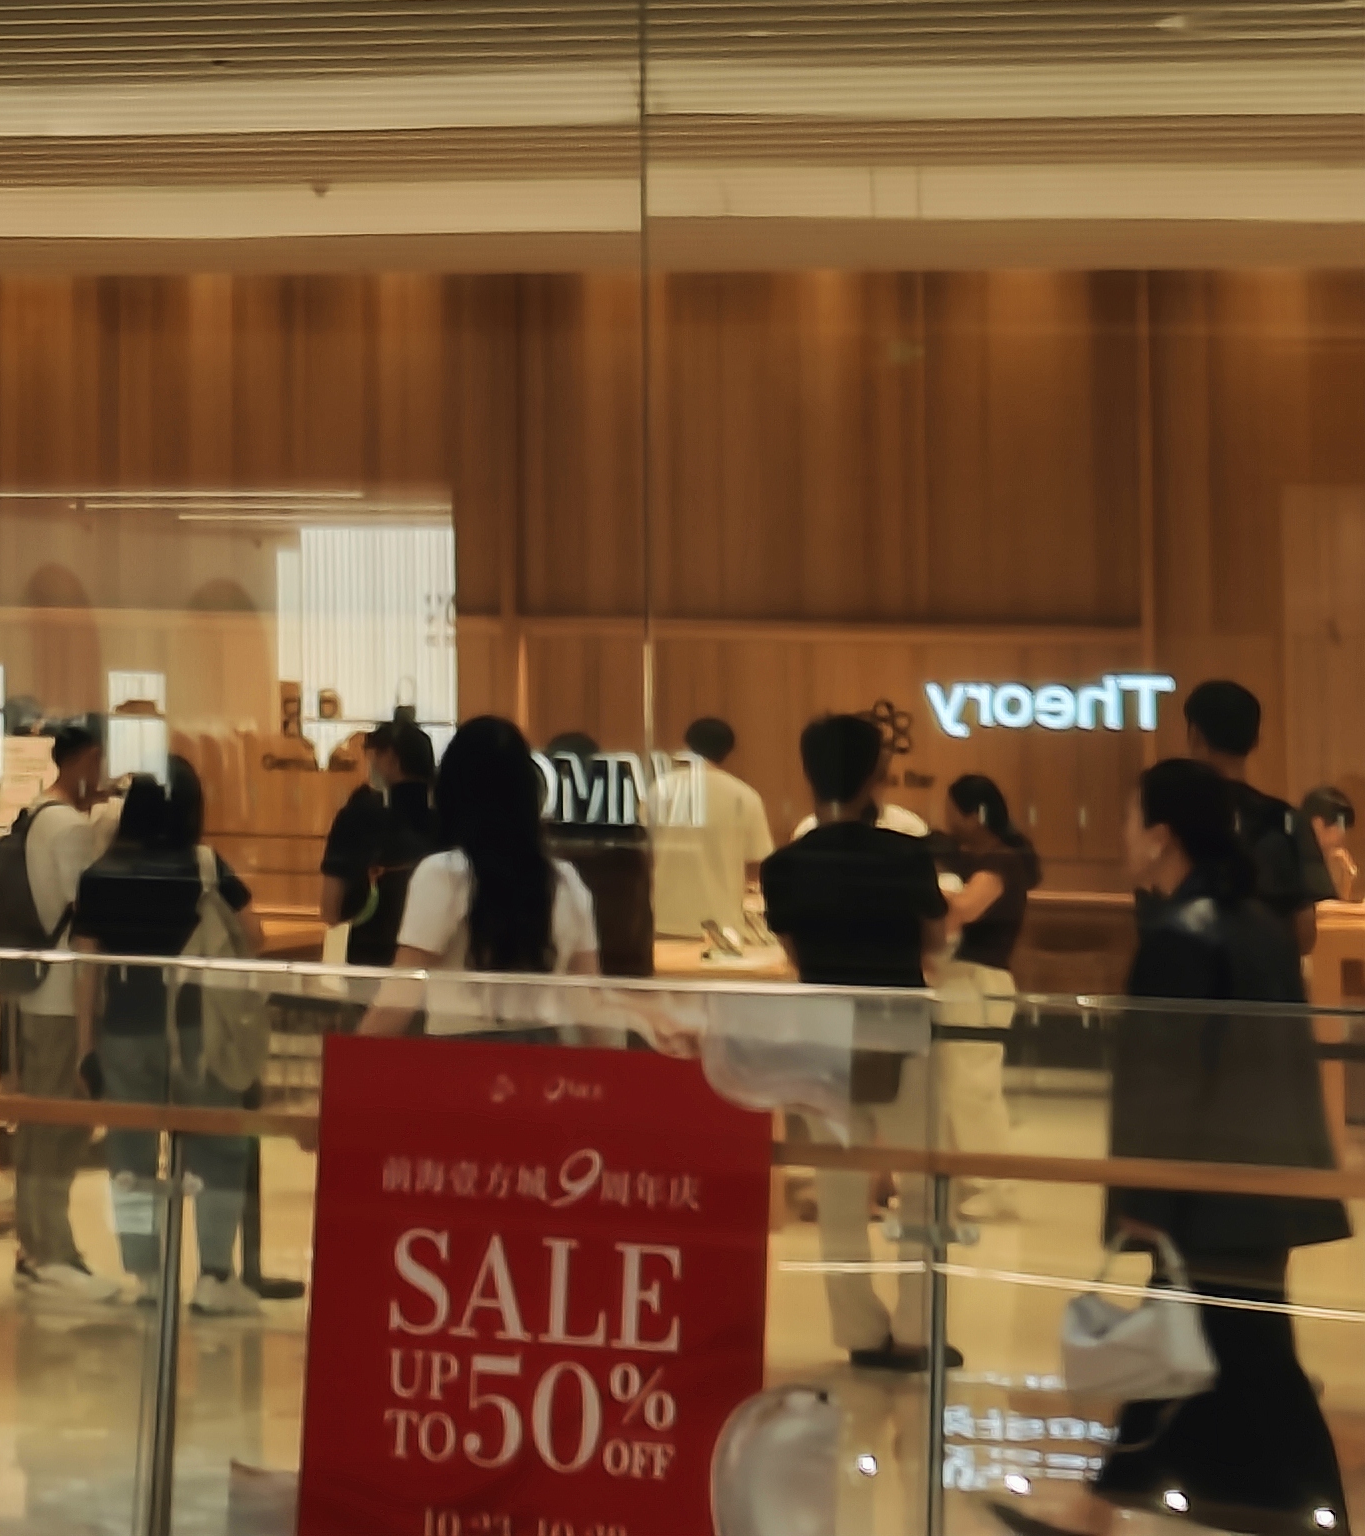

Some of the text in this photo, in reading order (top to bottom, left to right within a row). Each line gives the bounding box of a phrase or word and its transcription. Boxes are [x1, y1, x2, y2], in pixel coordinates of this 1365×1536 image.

[388, 1228, 682, 1352] SALE
[384, 1354, 676, 1479] TO 50% OFF
[389, 1349, 458, 1400] UP
